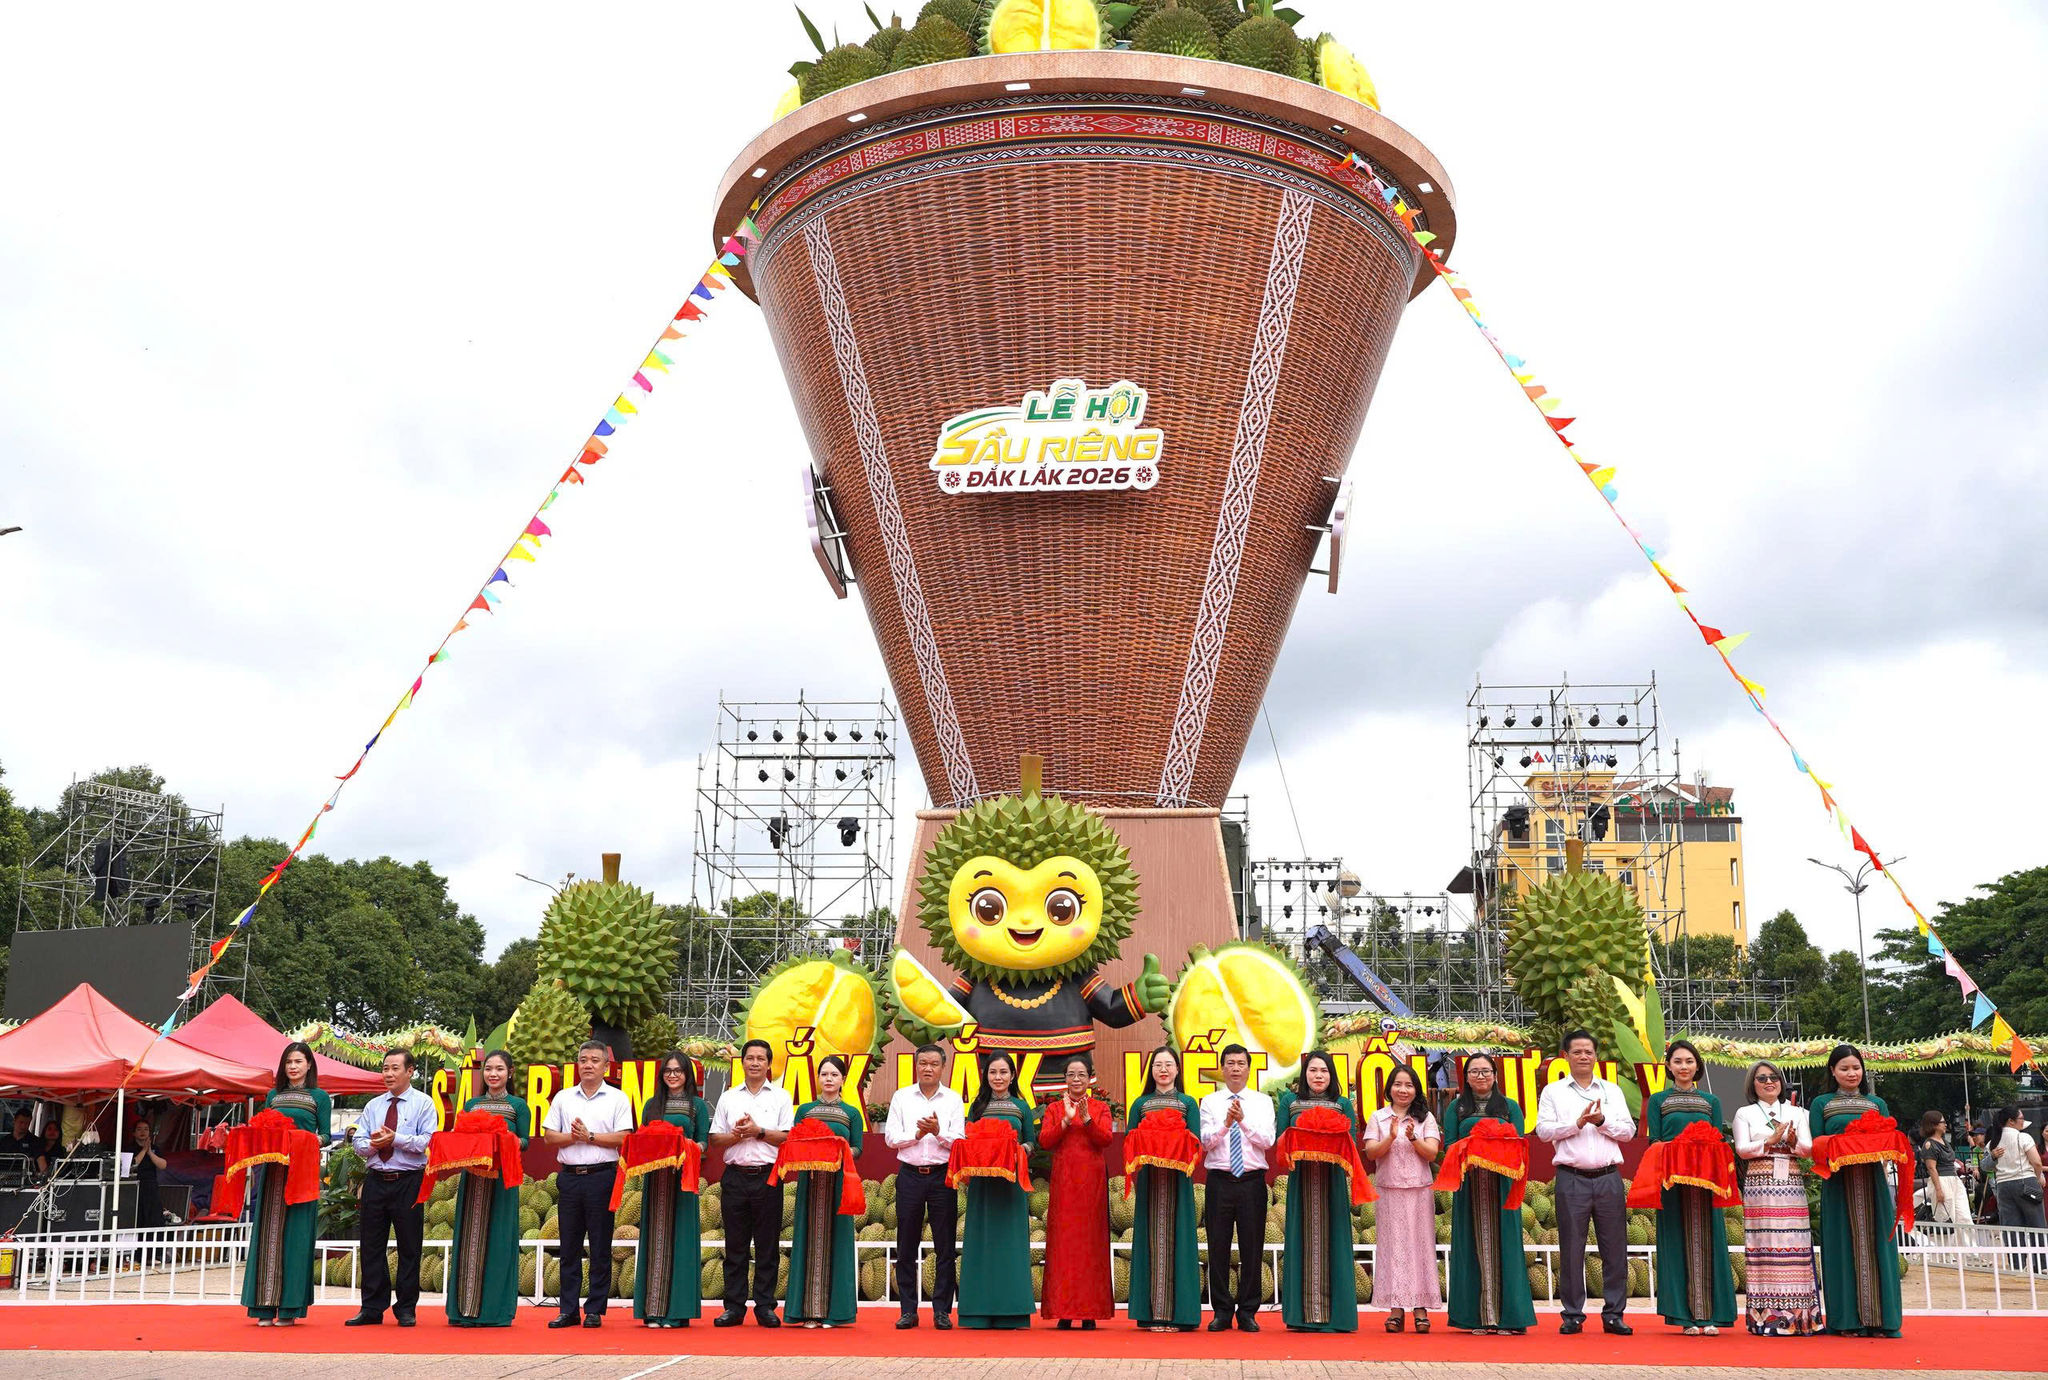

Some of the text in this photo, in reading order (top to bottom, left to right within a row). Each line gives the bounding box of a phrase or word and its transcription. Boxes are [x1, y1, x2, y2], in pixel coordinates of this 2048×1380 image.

[1026, 384, 1140, 424] LỄ HỘI
[935, 426, 1160, 466] SẦU RIÊNG
[967, 464, 1130, 487] ĐẮK LẮK 2026
